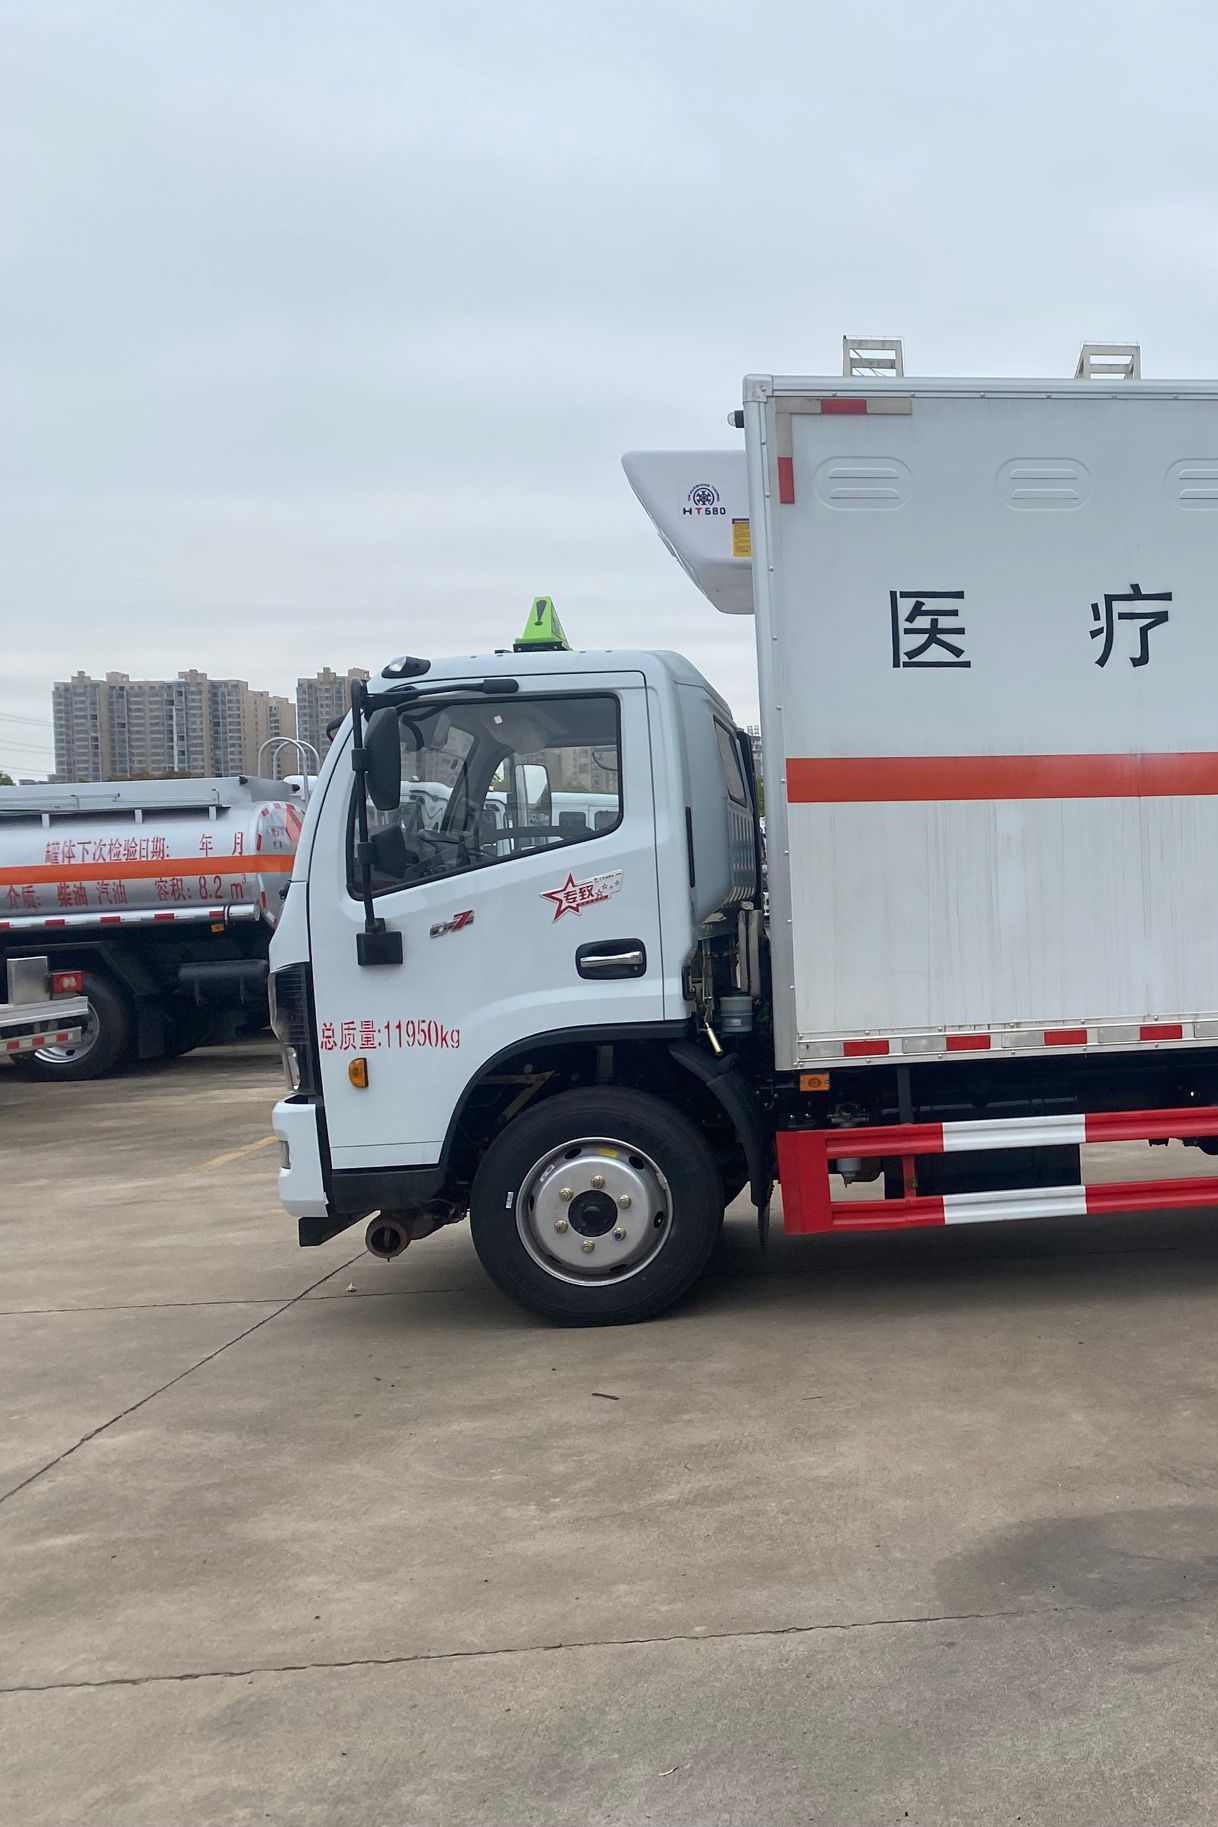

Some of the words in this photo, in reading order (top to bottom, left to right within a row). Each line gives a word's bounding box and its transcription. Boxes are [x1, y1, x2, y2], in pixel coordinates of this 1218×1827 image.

[199, 833, 213, 857] 年
[232, 831, 244, 856] 月
[199, 876, 223, 899] 8.2
